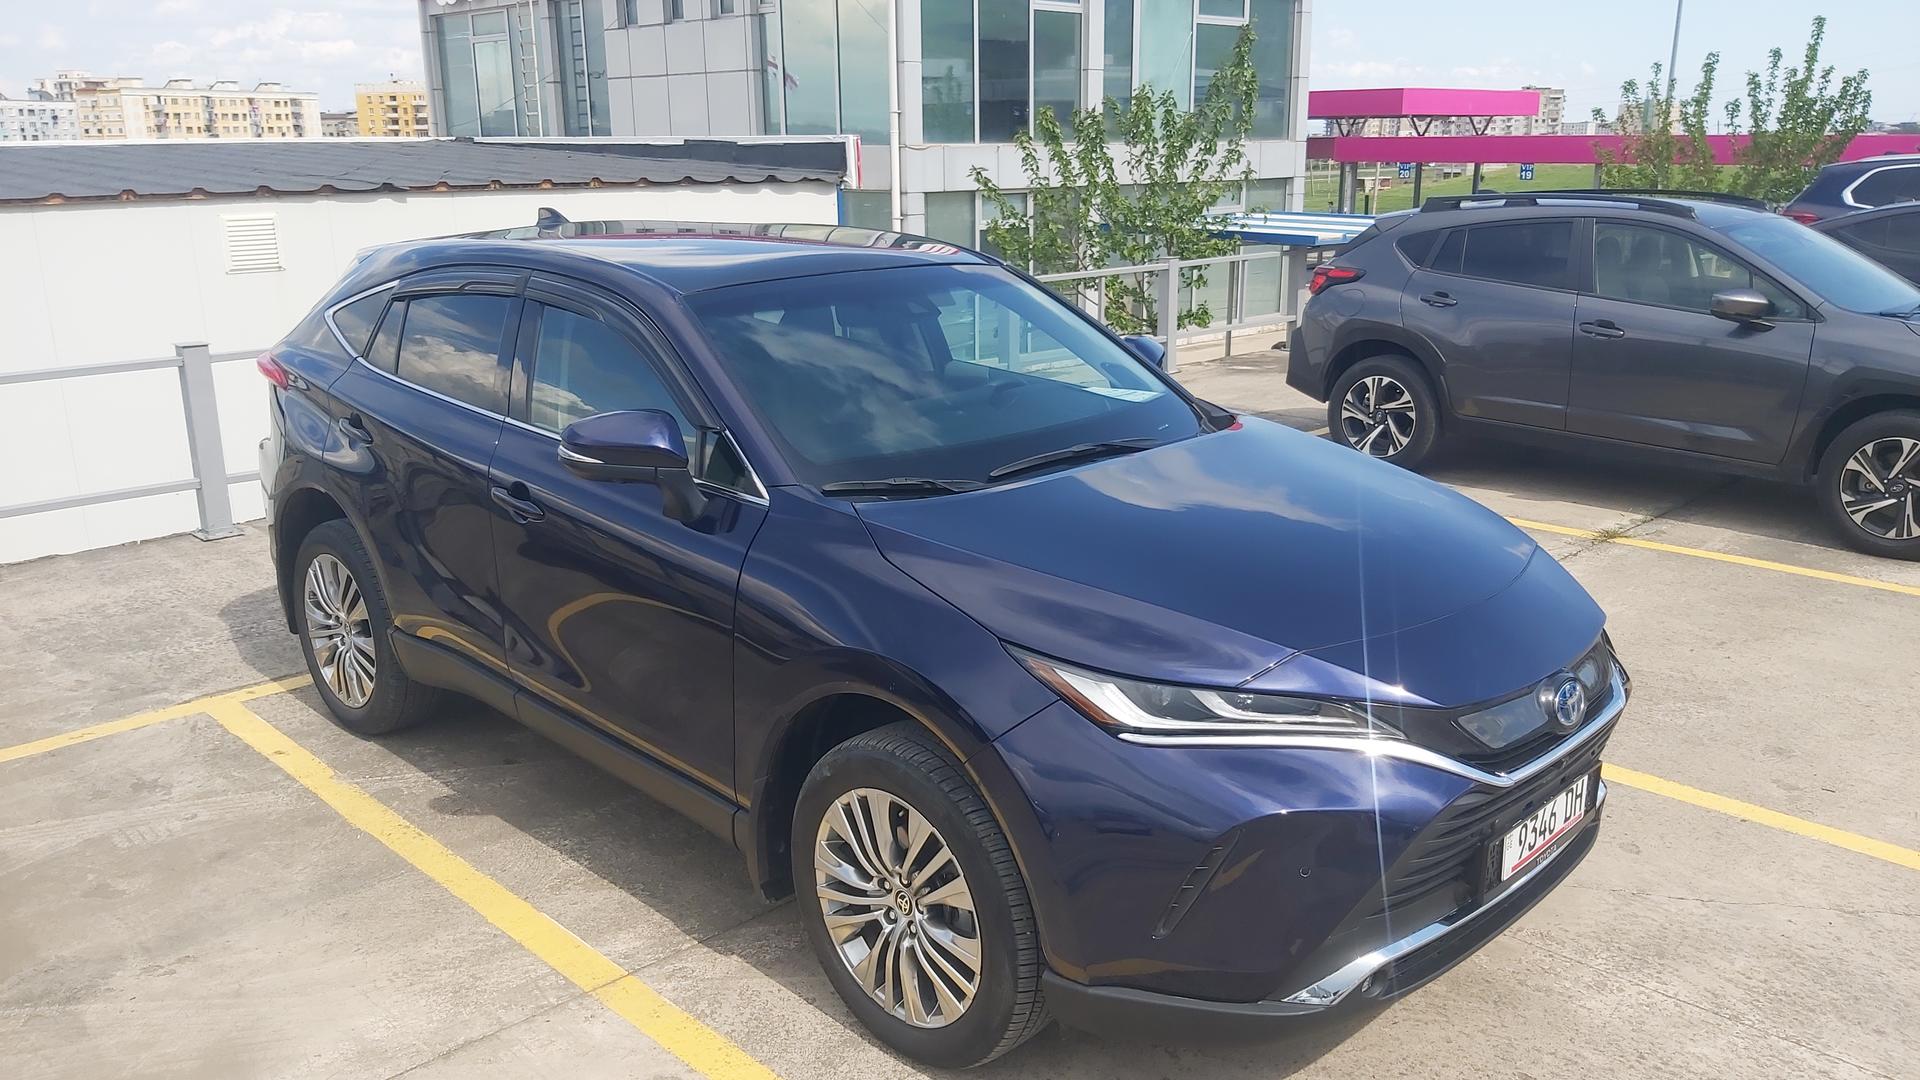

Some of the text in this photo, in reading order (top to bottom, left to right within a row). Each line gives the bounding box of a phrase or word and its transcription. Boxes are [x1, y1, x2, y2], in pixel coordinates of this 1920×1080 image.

[1399, 170, 1410, 178] 20
[1520, 171, 1532, 179] 19
[1518, 778, 1585, 861] 9346 DH
